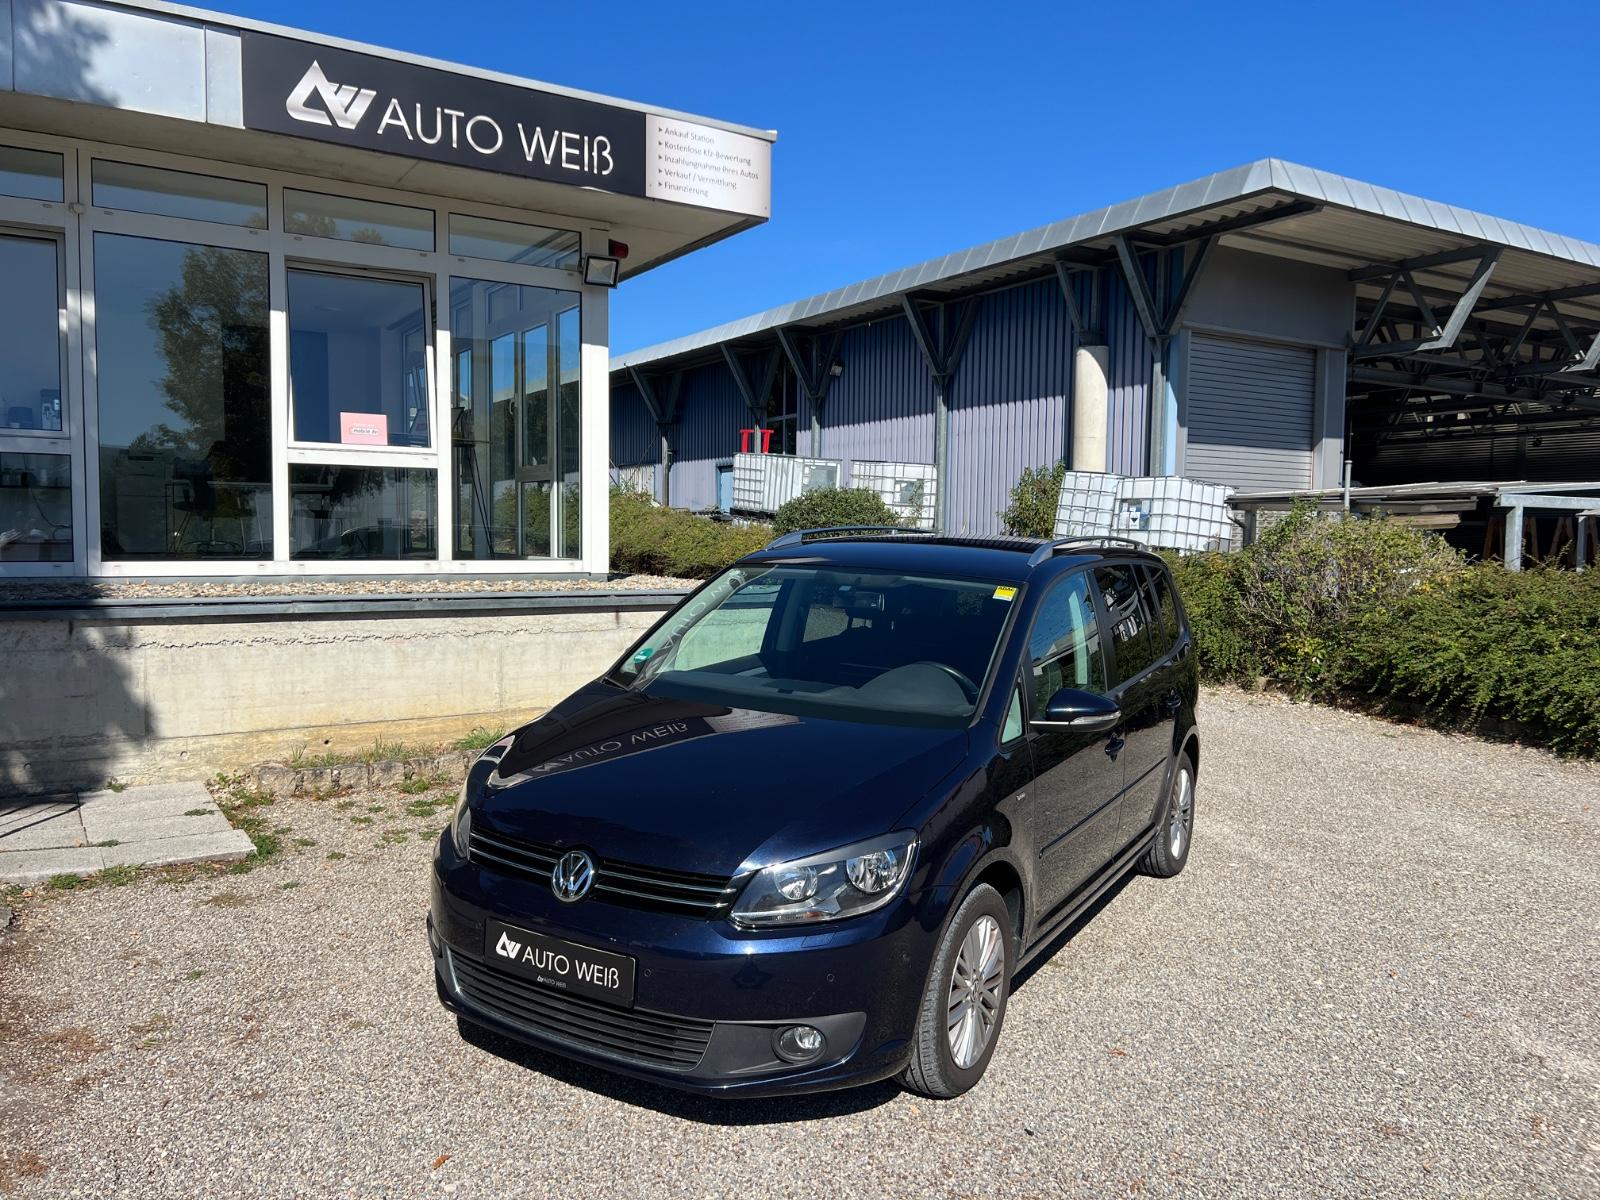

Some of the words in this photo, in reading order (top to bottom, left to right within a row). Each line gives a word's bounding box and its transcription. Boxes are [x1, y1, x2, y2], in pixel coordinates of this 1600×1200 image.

[377, 98, 503, 154] AUTO
[517, 122, 614, 176] WEIß
[664, 127, 689, 138] Ankauf
[690, 132, 714, 144] Station
[664, 141, 702, 154] Kostenlose
[664, 168, 691, 180] Verkauf
[740, 169, 759, 180] Autos
[664, 181, 709, 197] Finanzierung
[522, 946, 569, 975] AUTO
[575, 959, 619, 989] WEIß
